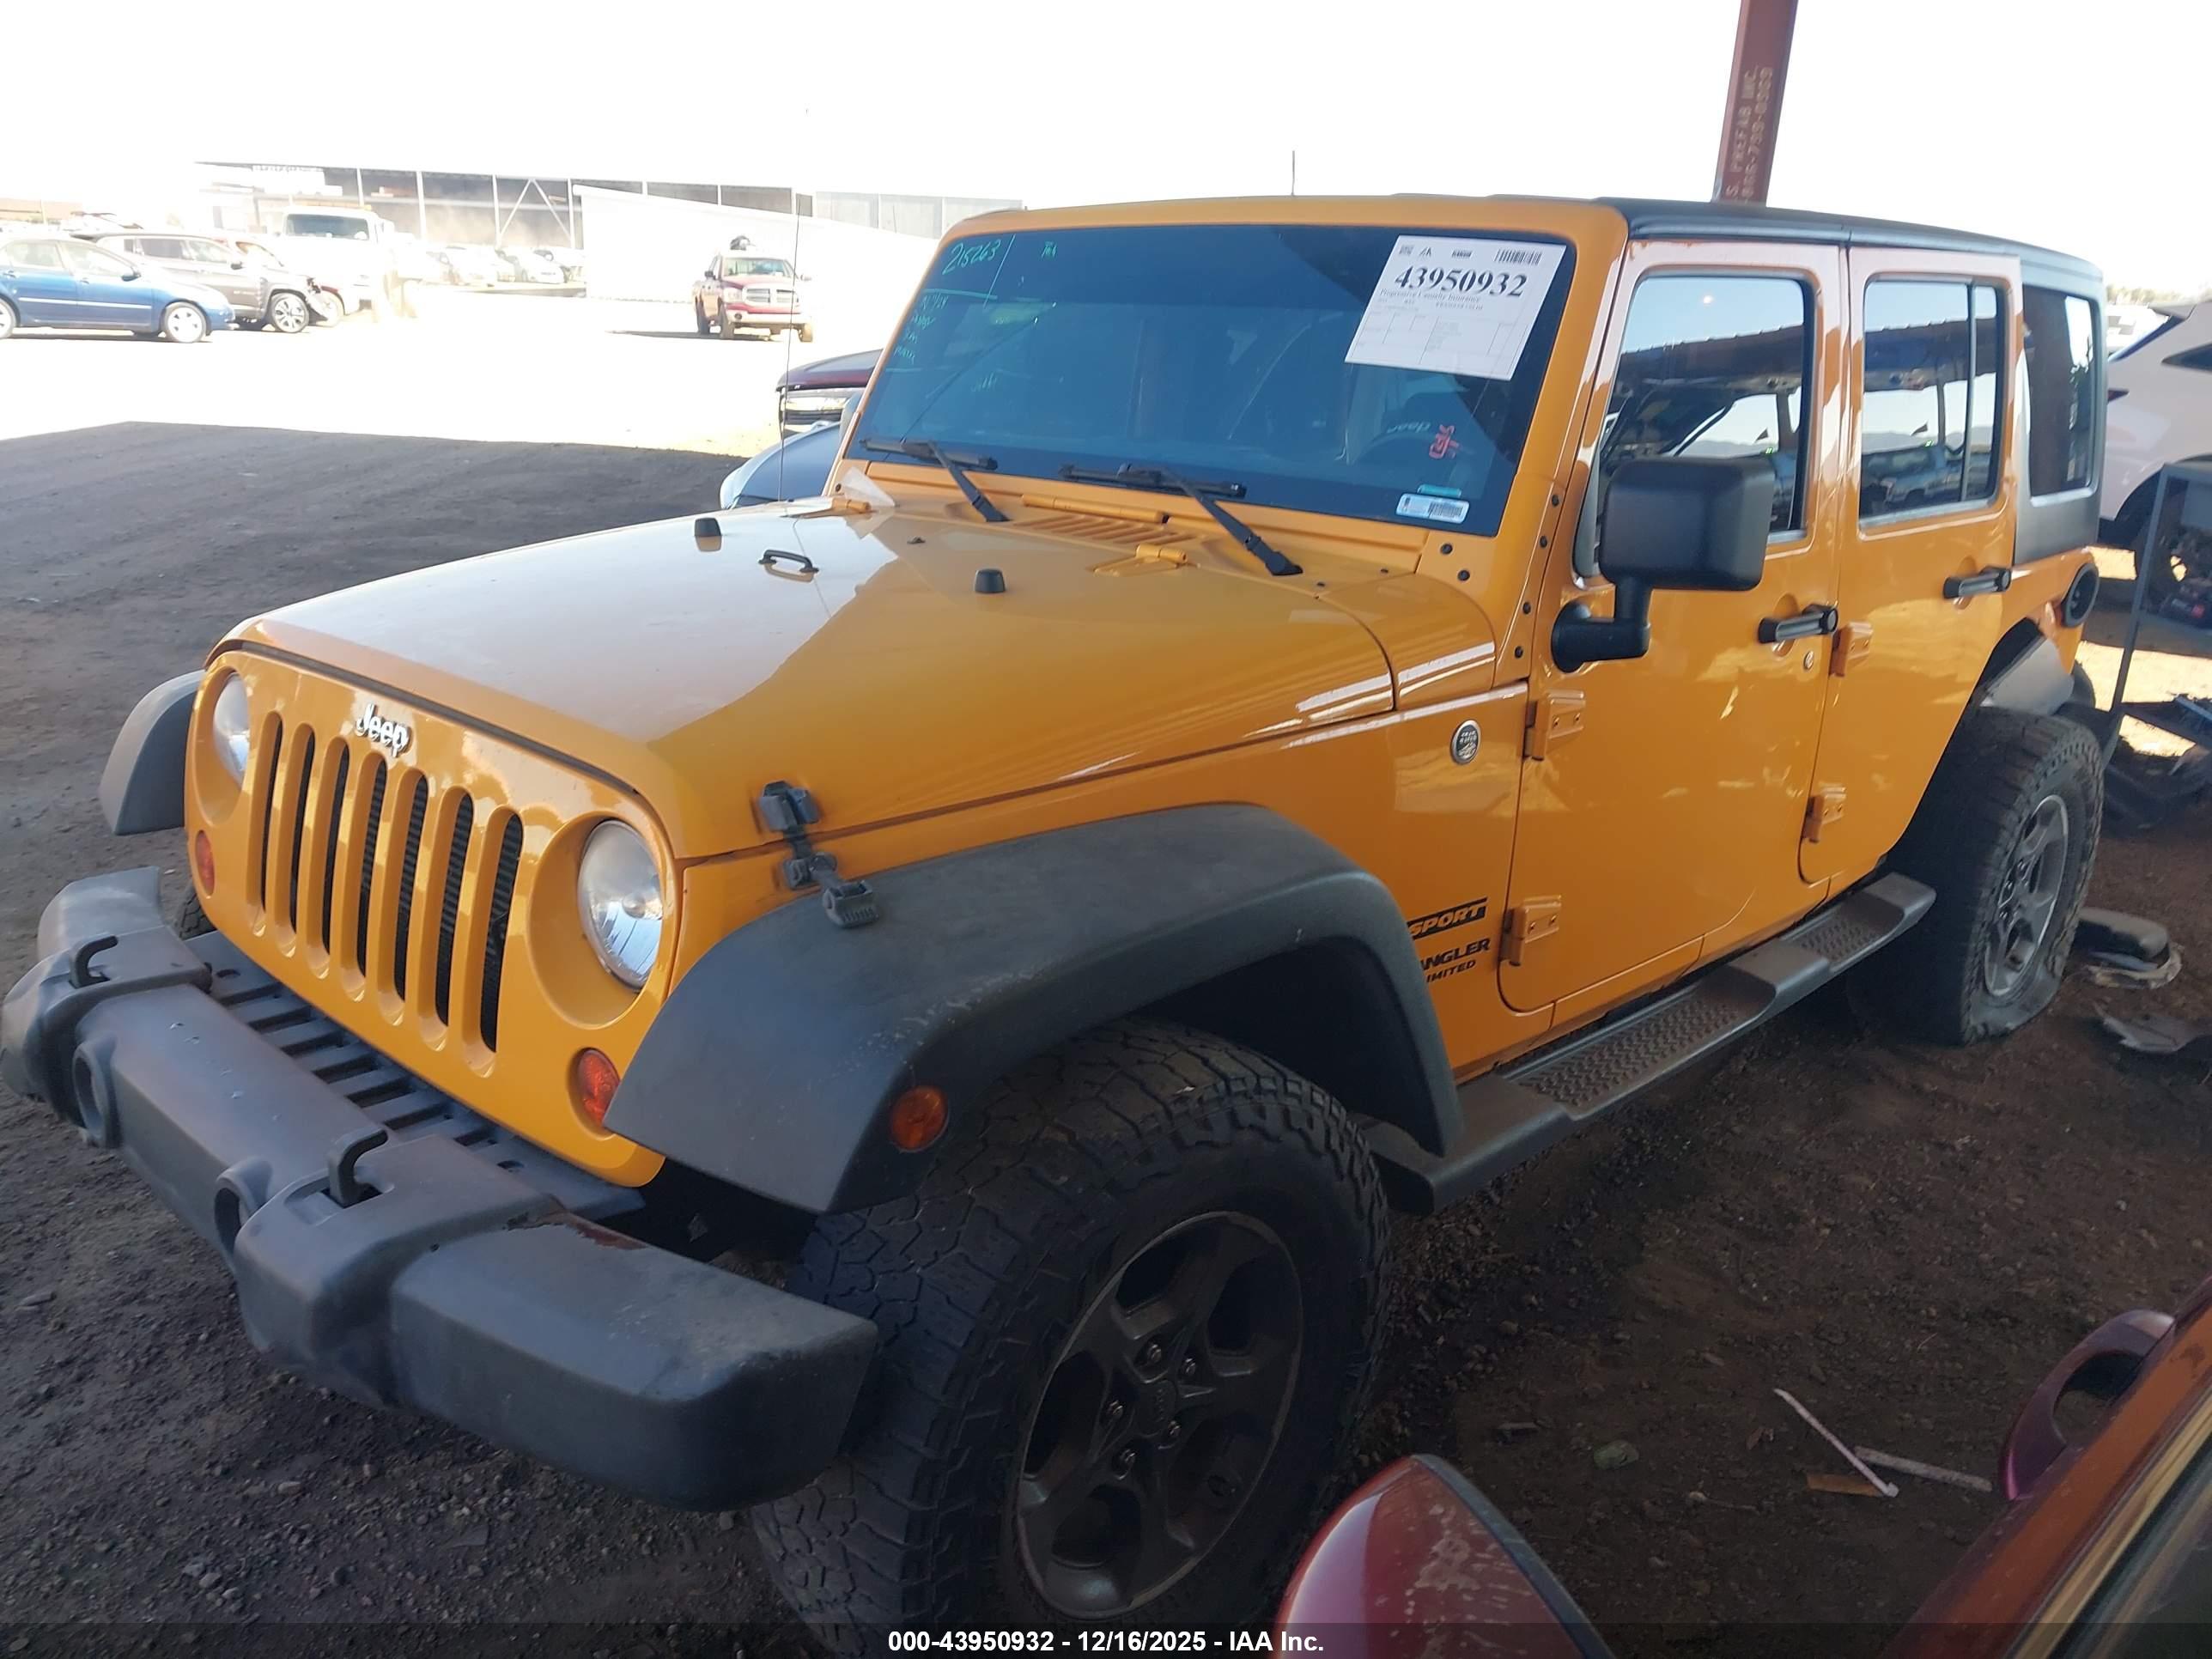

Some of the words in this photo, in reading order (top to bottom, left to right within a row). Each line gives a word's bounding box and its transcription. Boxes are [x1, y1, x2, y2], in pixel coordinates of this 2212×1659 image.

[1395, 265, 1528, 298] 43950932
[356, 703, 410, 757] Jeep
[1408, 904, 1486, 936] SPORT
[1426, 959, 1476, 982] IMITED
